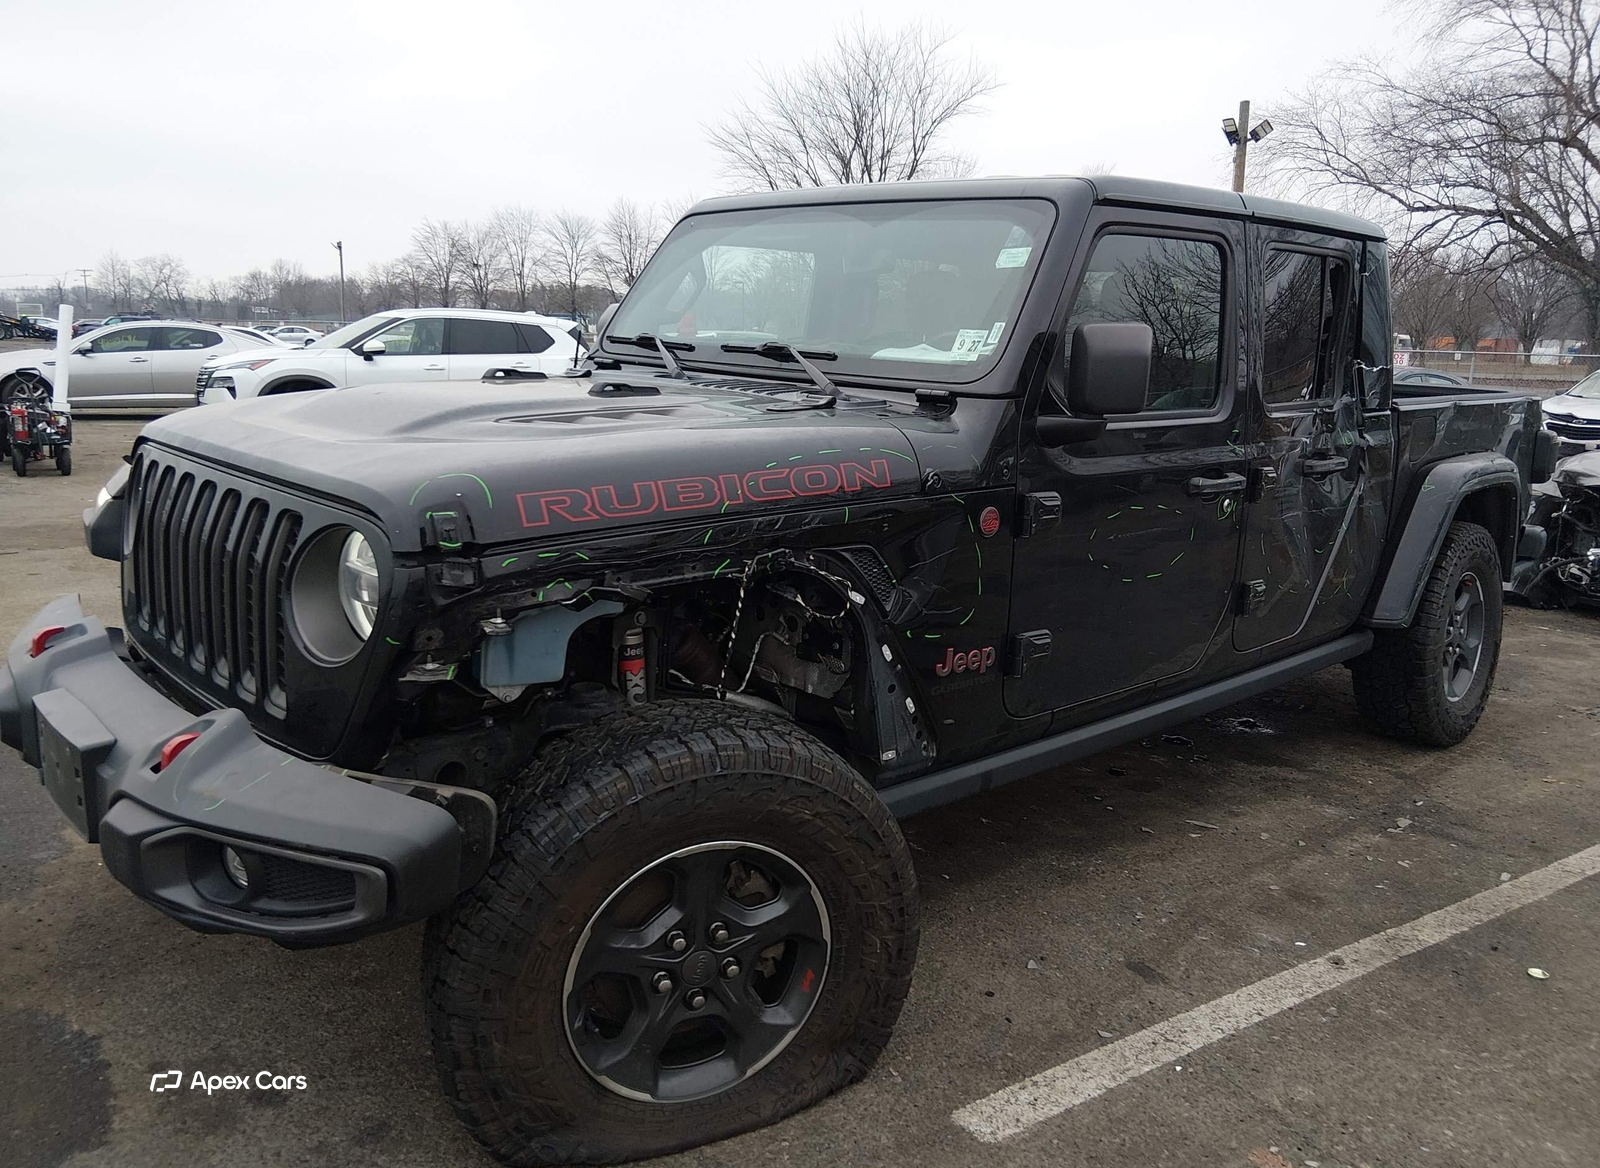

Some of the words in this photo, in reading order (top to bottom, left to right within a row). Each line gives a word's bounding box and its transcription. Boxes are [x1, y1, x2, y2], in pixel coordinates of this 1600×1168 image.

[957, 338, 966, 351] 9
[967, 339, 982, 353] 27
[515, 459, 892, 527] RUBICON
[935, 646, 996, 677] Jeep
